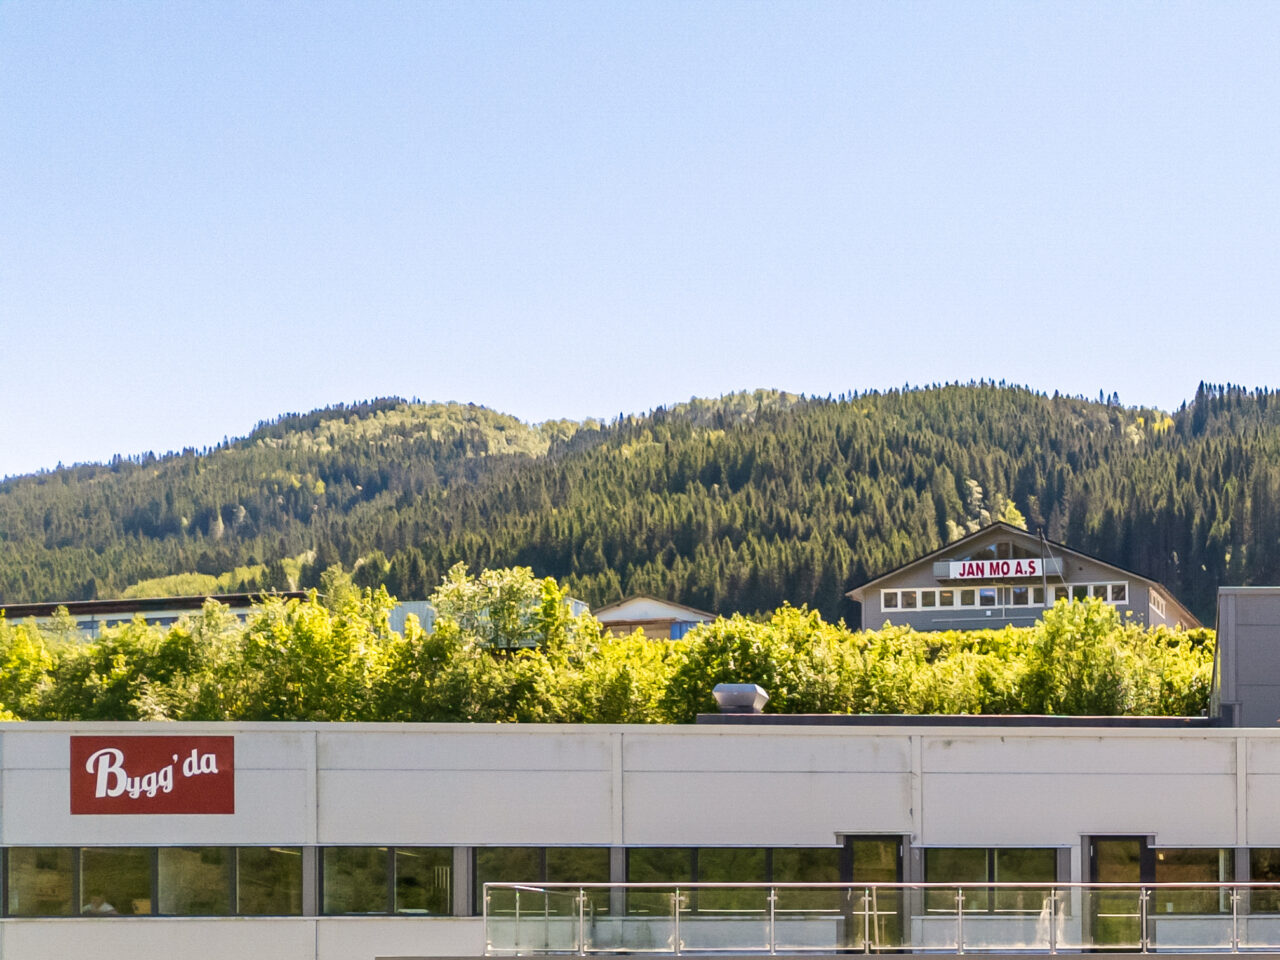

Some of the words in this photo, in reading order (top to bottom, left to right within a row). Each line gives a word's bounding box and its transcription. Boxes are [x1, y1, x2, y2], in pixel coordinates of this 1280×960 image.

[959, 562, 984, 577] JAN
[989, 561, 1010, 576] MO
[1015, 560, 1036, 575] A.S
